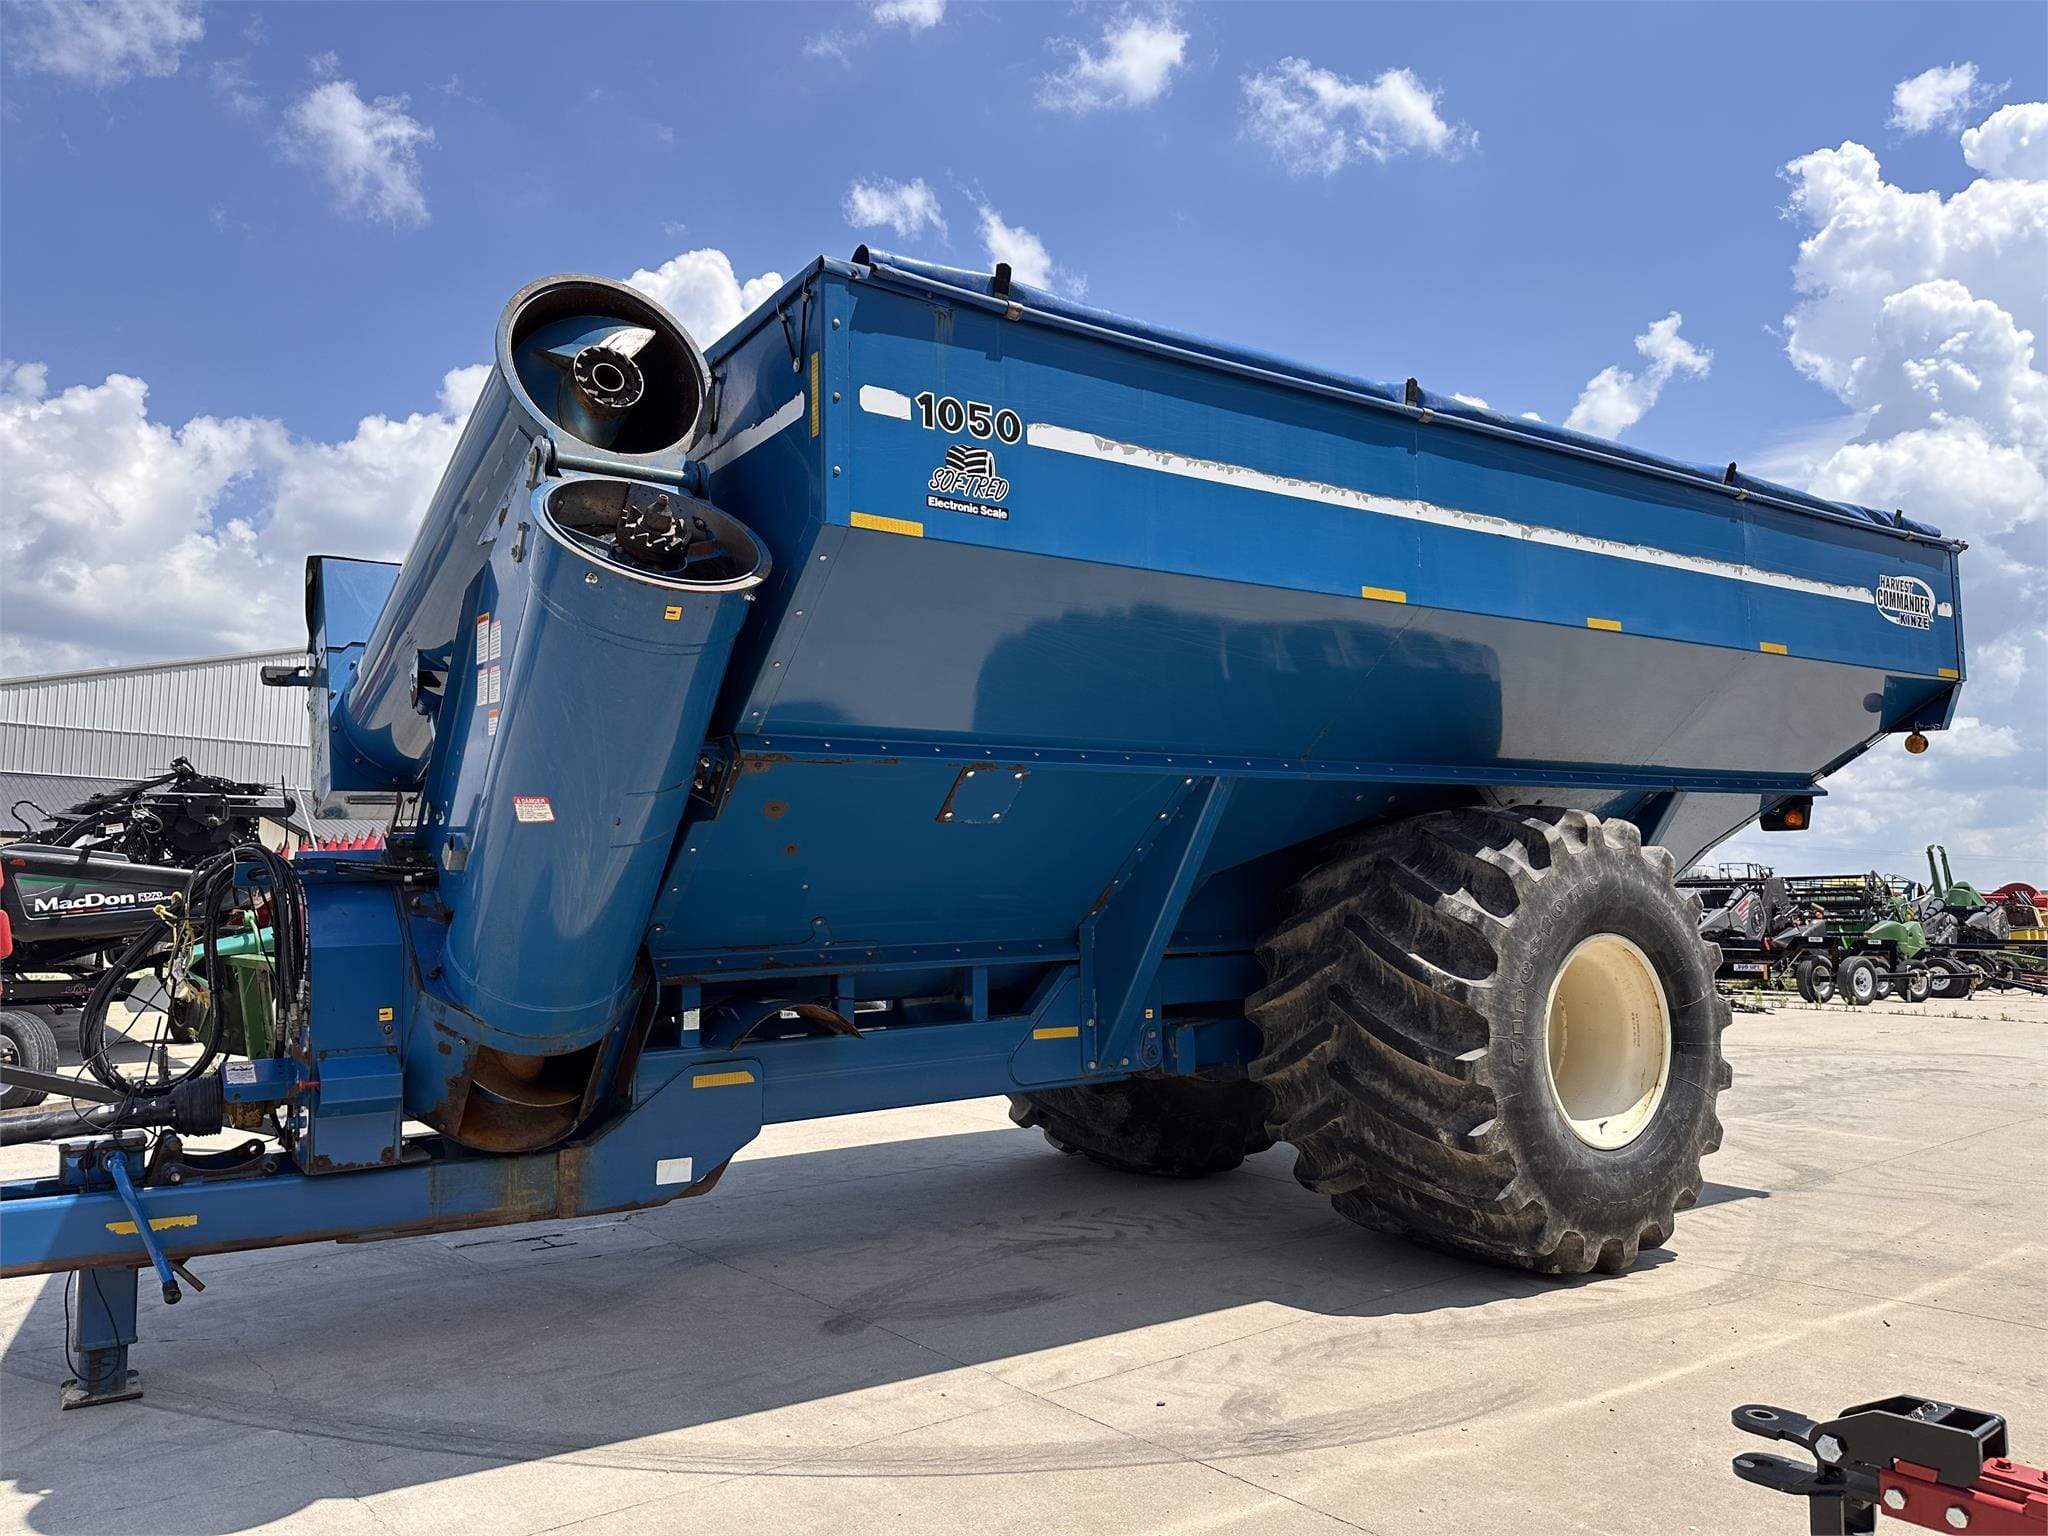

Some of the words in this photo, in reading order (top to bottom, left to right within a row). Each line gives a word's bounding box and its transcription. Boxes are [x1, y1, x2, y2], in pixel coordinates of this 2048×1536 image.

[915, 391, 1022, 444] 1050
[928, 496, 979, 514] Electronic
[980, 506, 1008, 519] Scale
[1880, 575, 1913, 593] HARVEST
[1877, 588, 1933, 620] COMMANDER
[1900, 613, 1929, 629] KINZE
[34, 893, 135, 912] MacDon
